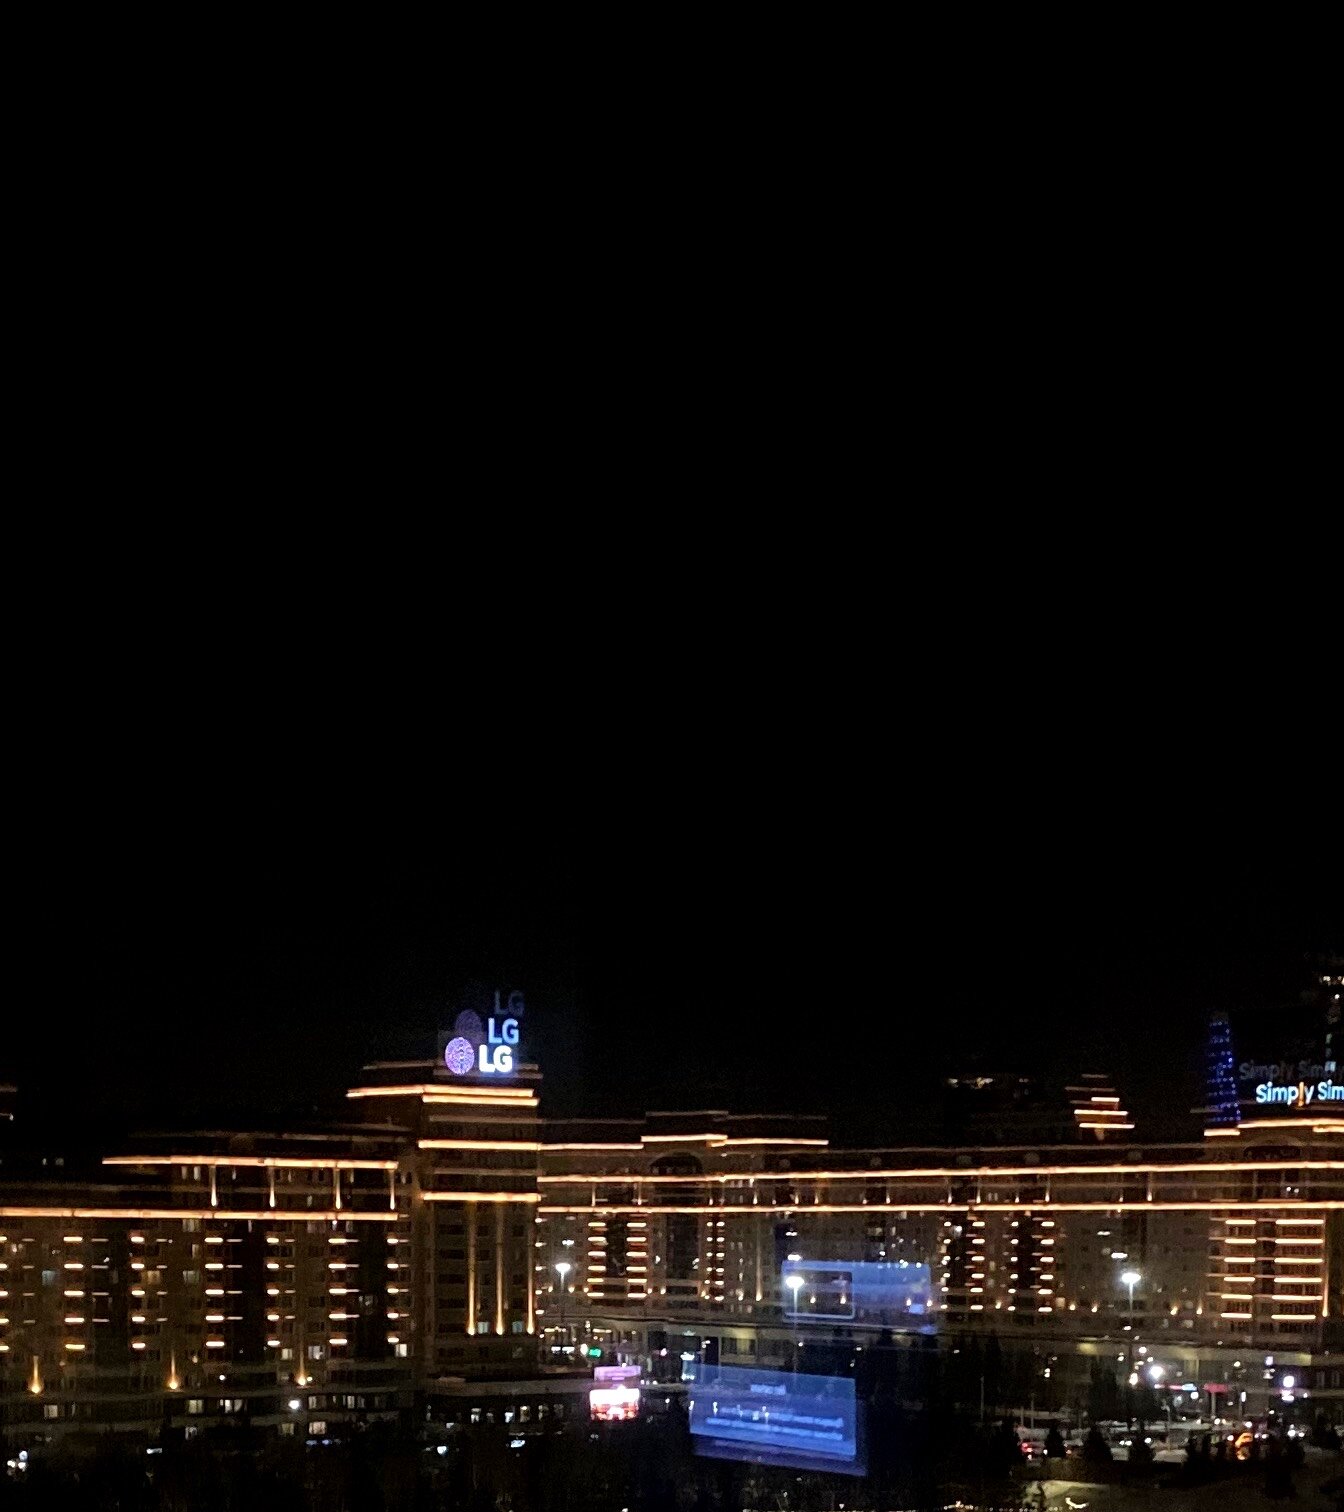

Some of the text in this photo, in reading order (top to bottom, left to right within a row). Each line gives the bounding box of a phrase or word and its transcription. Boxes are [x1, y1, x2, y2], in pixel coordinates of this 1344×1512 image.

[487, 1017, 519, 1044] LG
[478, 1045, 513, 1072] LG
[1255, 1081, 1315, 1107] Simply
